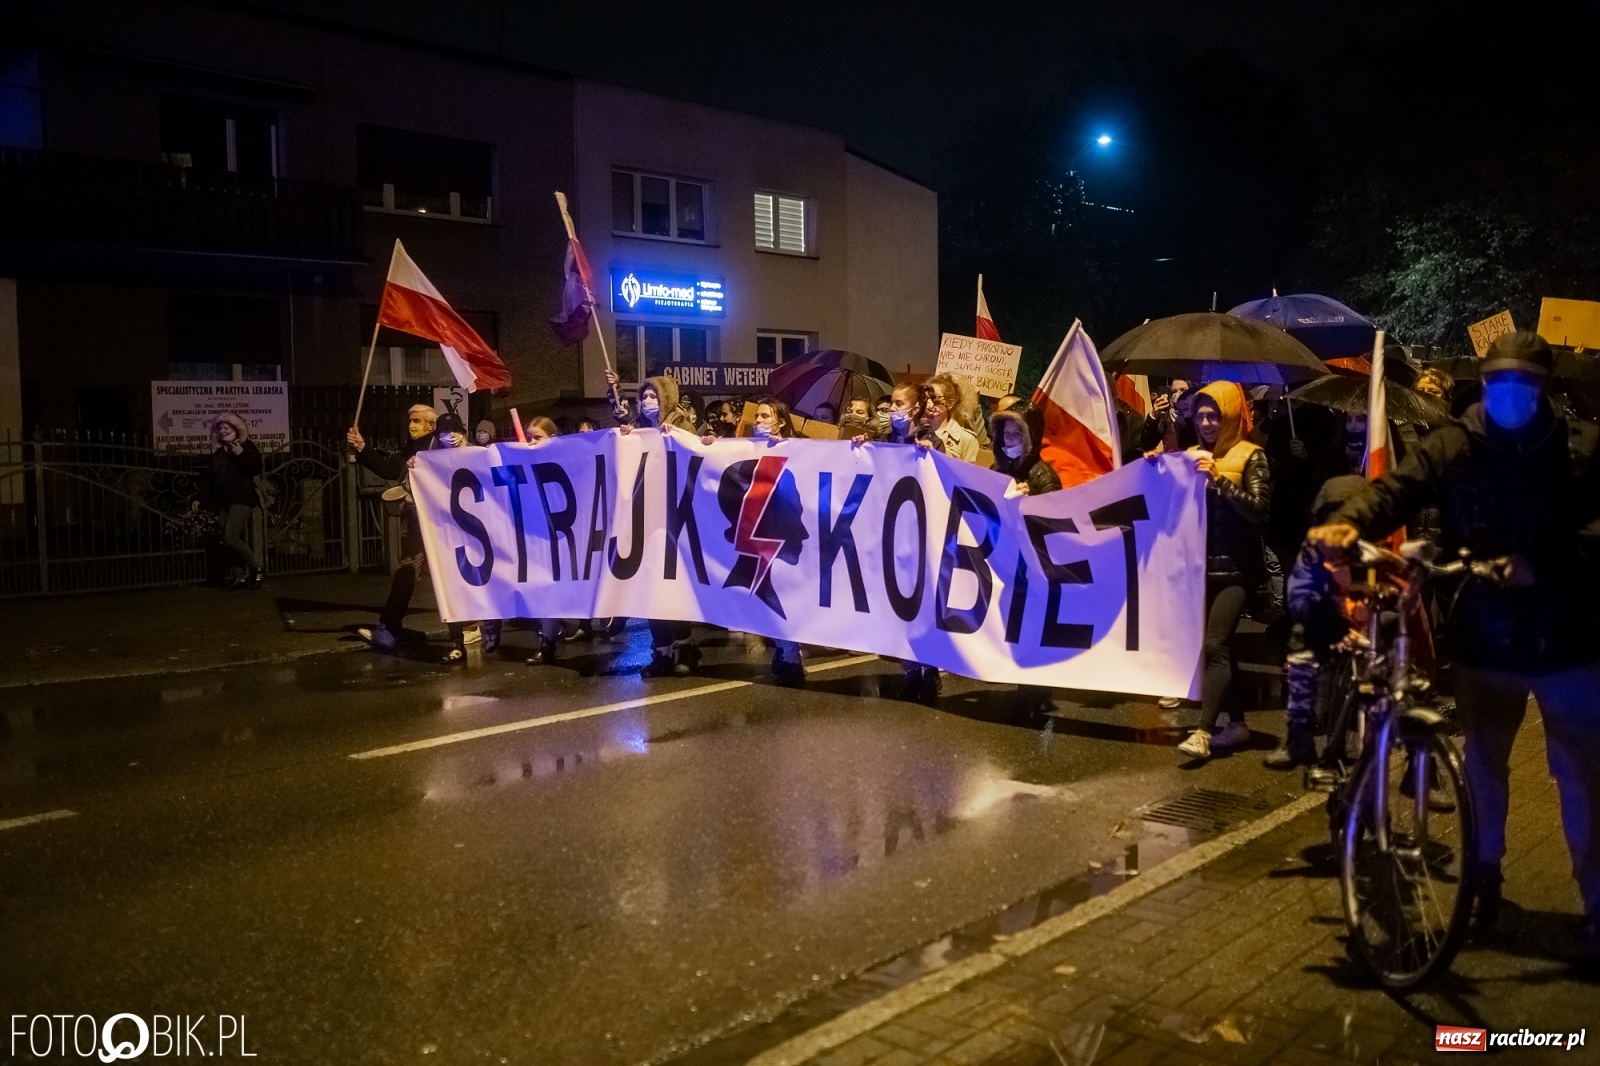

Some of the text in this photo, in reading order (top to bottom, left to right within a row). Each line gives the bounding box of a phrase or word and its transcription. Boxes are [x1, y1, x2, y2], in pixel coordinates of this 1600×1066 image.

[655, 299, 694, 308] FIZJOTERAPIA
[1472, 313, 1509, 338] STARE
[942, 336, 974, 350] KIEDY
[939, 350, 955, 360] NAS
[958, 351, 972, 361] NIE
[938, 360, 949, 369] MY
[954, 361, 982, 372] SWYCH
[663, 366, 774, 386] GABINET WETERY
[156, 386, 284, 395] SPECJALISTYCZNA PRAKTYKA LEKARSKA
[449, 450, 1150, 652] STRAJK KOBIET
